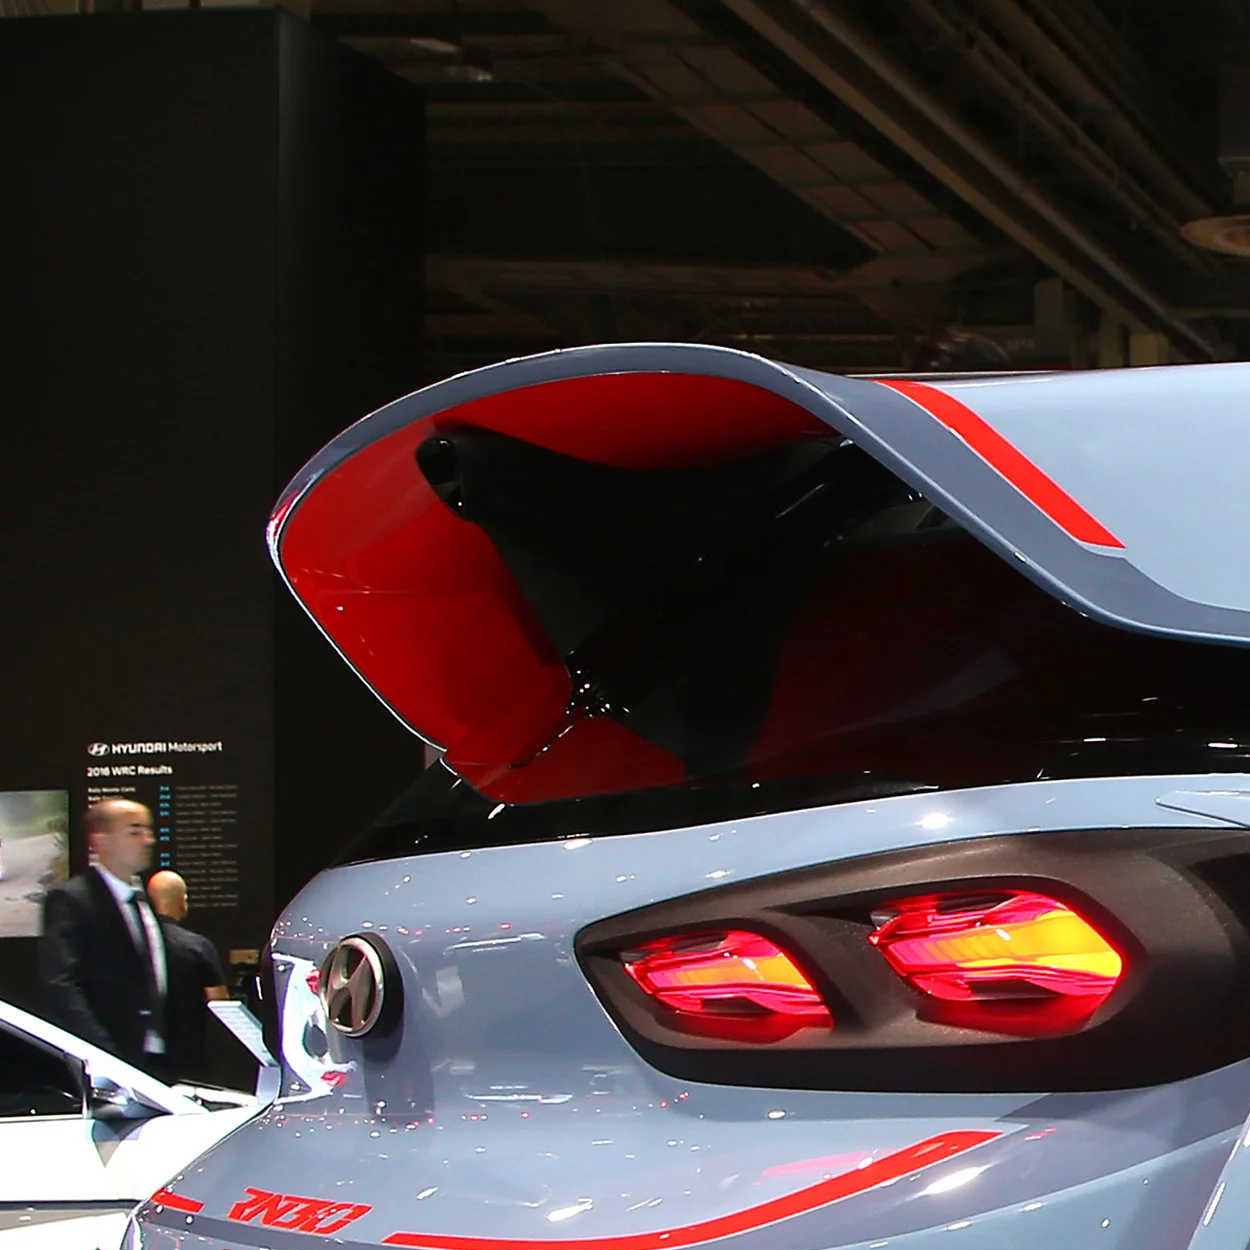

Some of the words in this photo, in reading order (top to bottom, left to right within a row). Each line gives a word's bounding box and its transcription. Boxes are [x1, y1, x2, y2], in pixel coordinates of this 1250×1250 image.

[112, 742, 167, 754] HYUNDAI
[168, 741, 223, 753] Motorsport
[87, 766, 110, 777] 2016
[111, 766, 136, 776] WRC
[138, 765, 173, 775] Results
